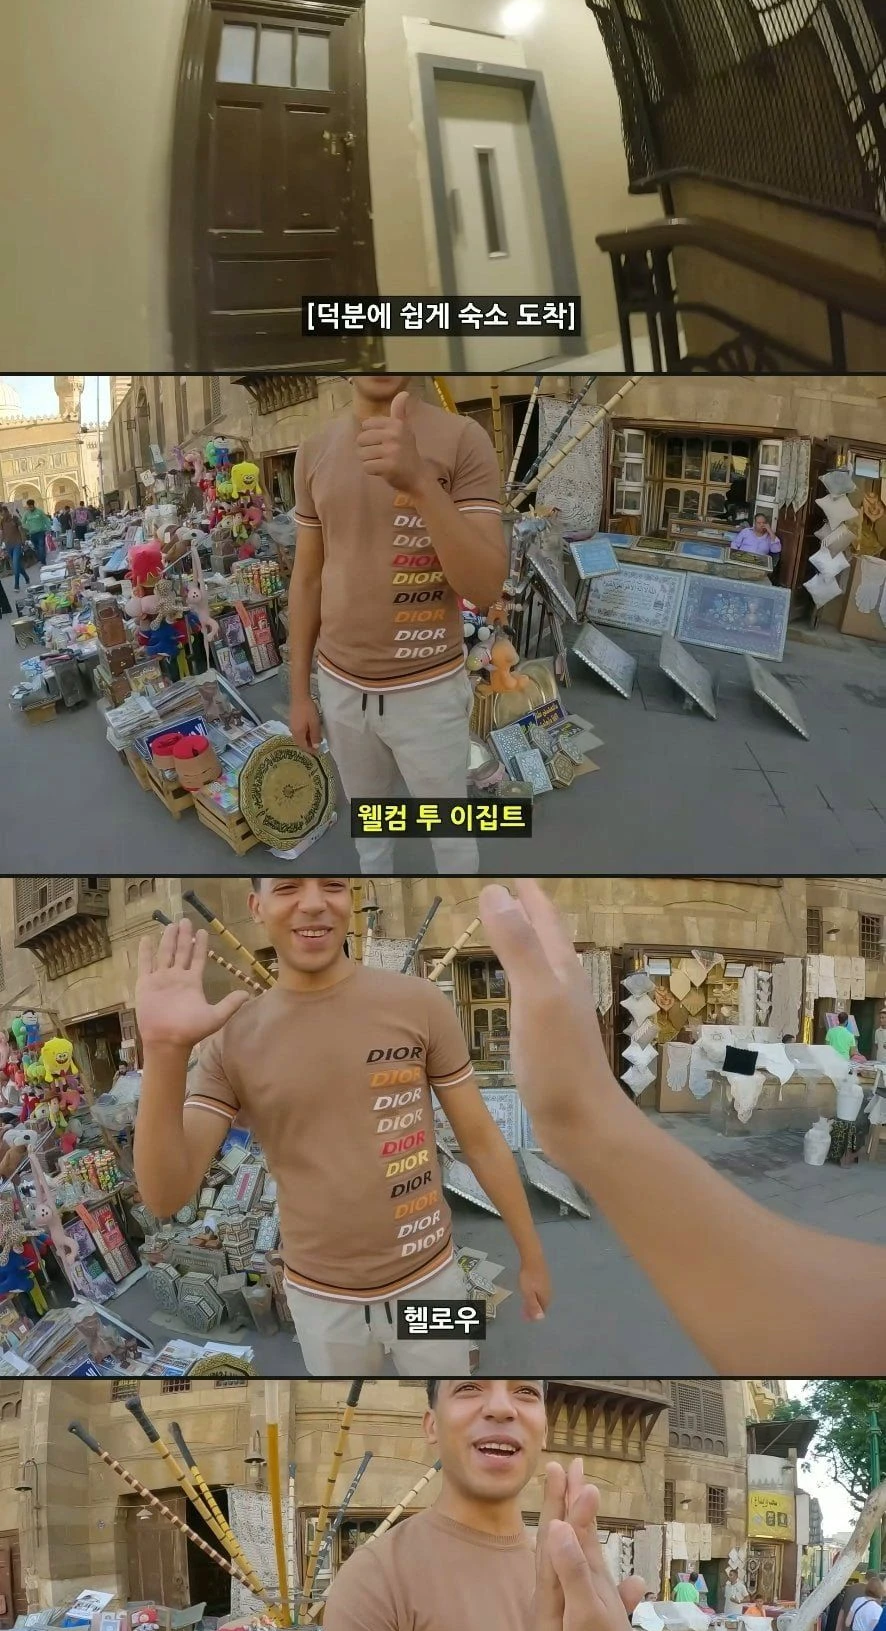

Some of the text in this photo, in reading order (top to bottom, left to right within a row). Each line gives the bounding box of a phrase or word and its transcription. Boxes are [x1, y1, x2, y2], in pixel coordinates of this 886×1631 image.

[393, 534, 431, 548] DIO
[392, 572, 443, 585] DIOR
[393, 590, 444, 604] DIOR
[395, 608, 445, 623] DIOR
[394, 628, 446, 641] DIOR
[394, 644, 447, 659] DIOR
[366, 1046, 423, 1064] DIOR
[371, 1068, 422, 1088] DIOR
[373, 1087, 422, 1111] DIOR
[377, 1108, 424, 1134] DIOR
[381, 1129, 426, 1157] DIOR
[385, 1149, 429, 1178] DIOR
[390, 1170, 432, 1199] DIOR
[395, 1194, 438, 1219] DIOR
[397, 1209, 441, 1239] DIOR
[401, 1226, 445, 1258] DIOR
